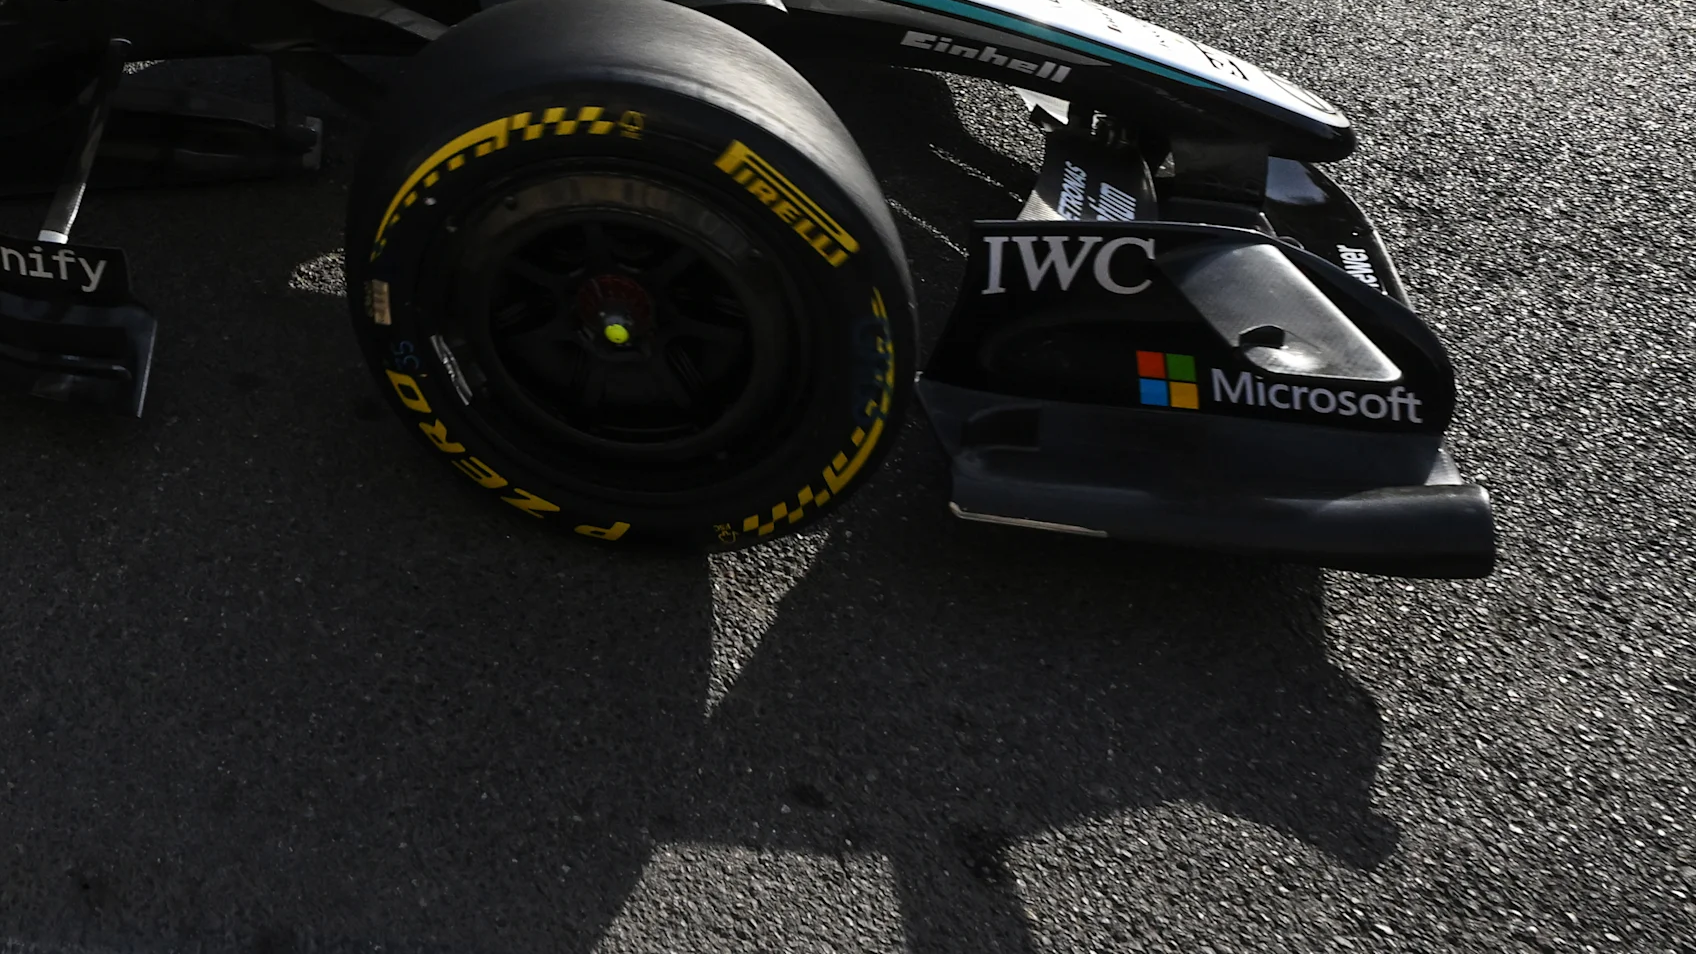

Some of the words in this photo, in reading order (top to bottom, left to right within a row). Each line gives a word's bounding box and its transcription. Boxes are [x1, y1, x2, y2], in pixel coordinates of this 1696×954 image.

[899, 29, 1072, 84] Einhell
[713, 138, 861, 259] PIRELLI
[1057, 160, 1088, 221] ETRONAS
[980, 235, 1156, 296] IWC
[1210, 367, 1424, 425] Microsoft
[384, 368, 561, 520] ZERO
